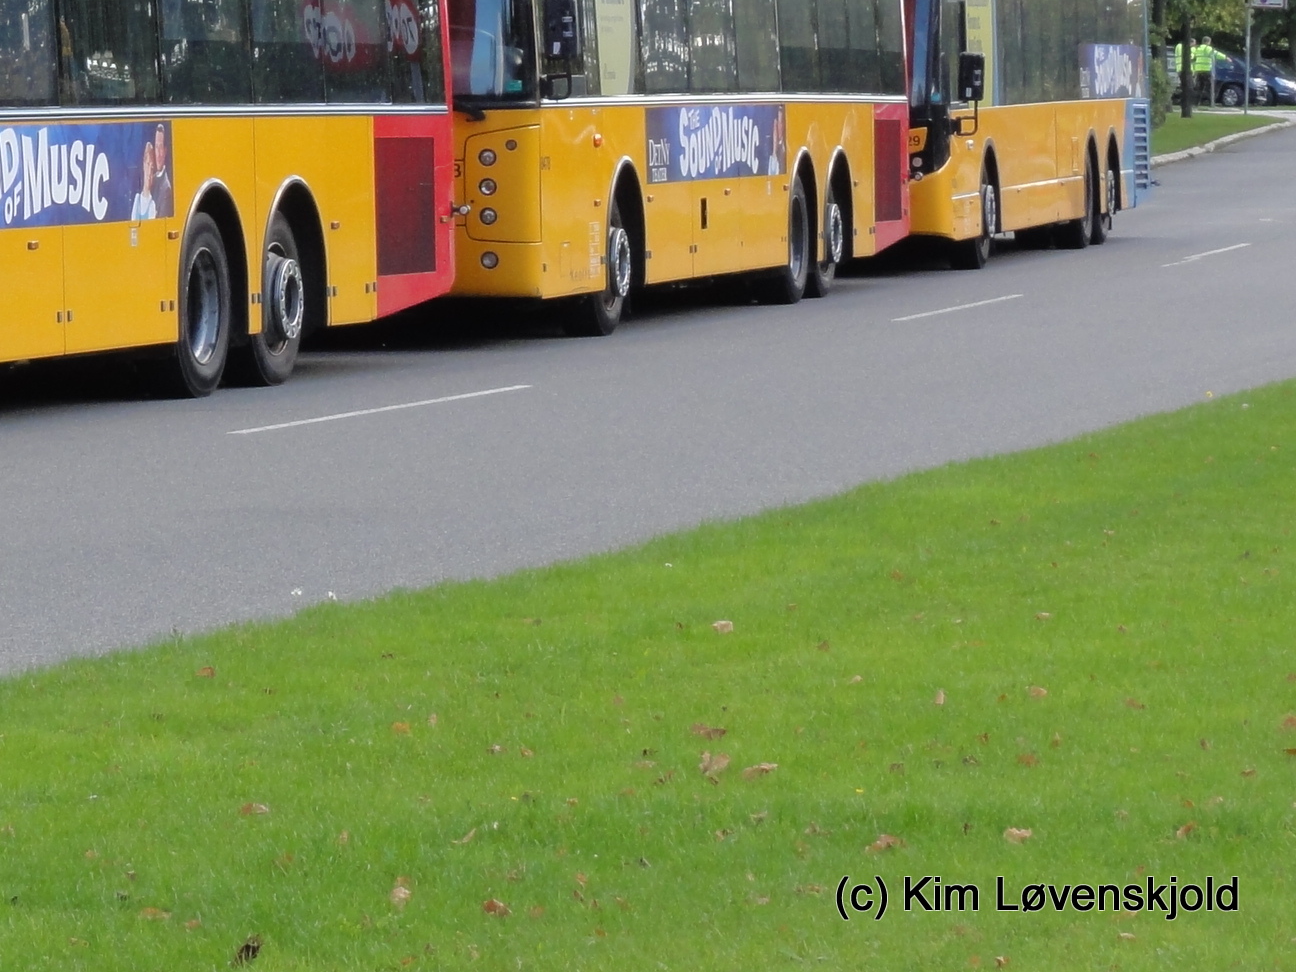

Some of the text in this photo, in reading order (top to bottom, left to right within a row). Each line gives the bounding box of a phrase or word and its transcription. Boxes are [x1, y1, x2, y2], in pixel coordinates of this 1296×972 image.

[21, 126, 110, 221] MUSIC
[679, 106, 721, 178] SOUND
[722, 106, 759, 175] MUSIC
[4, 181, 22, 225] OF
